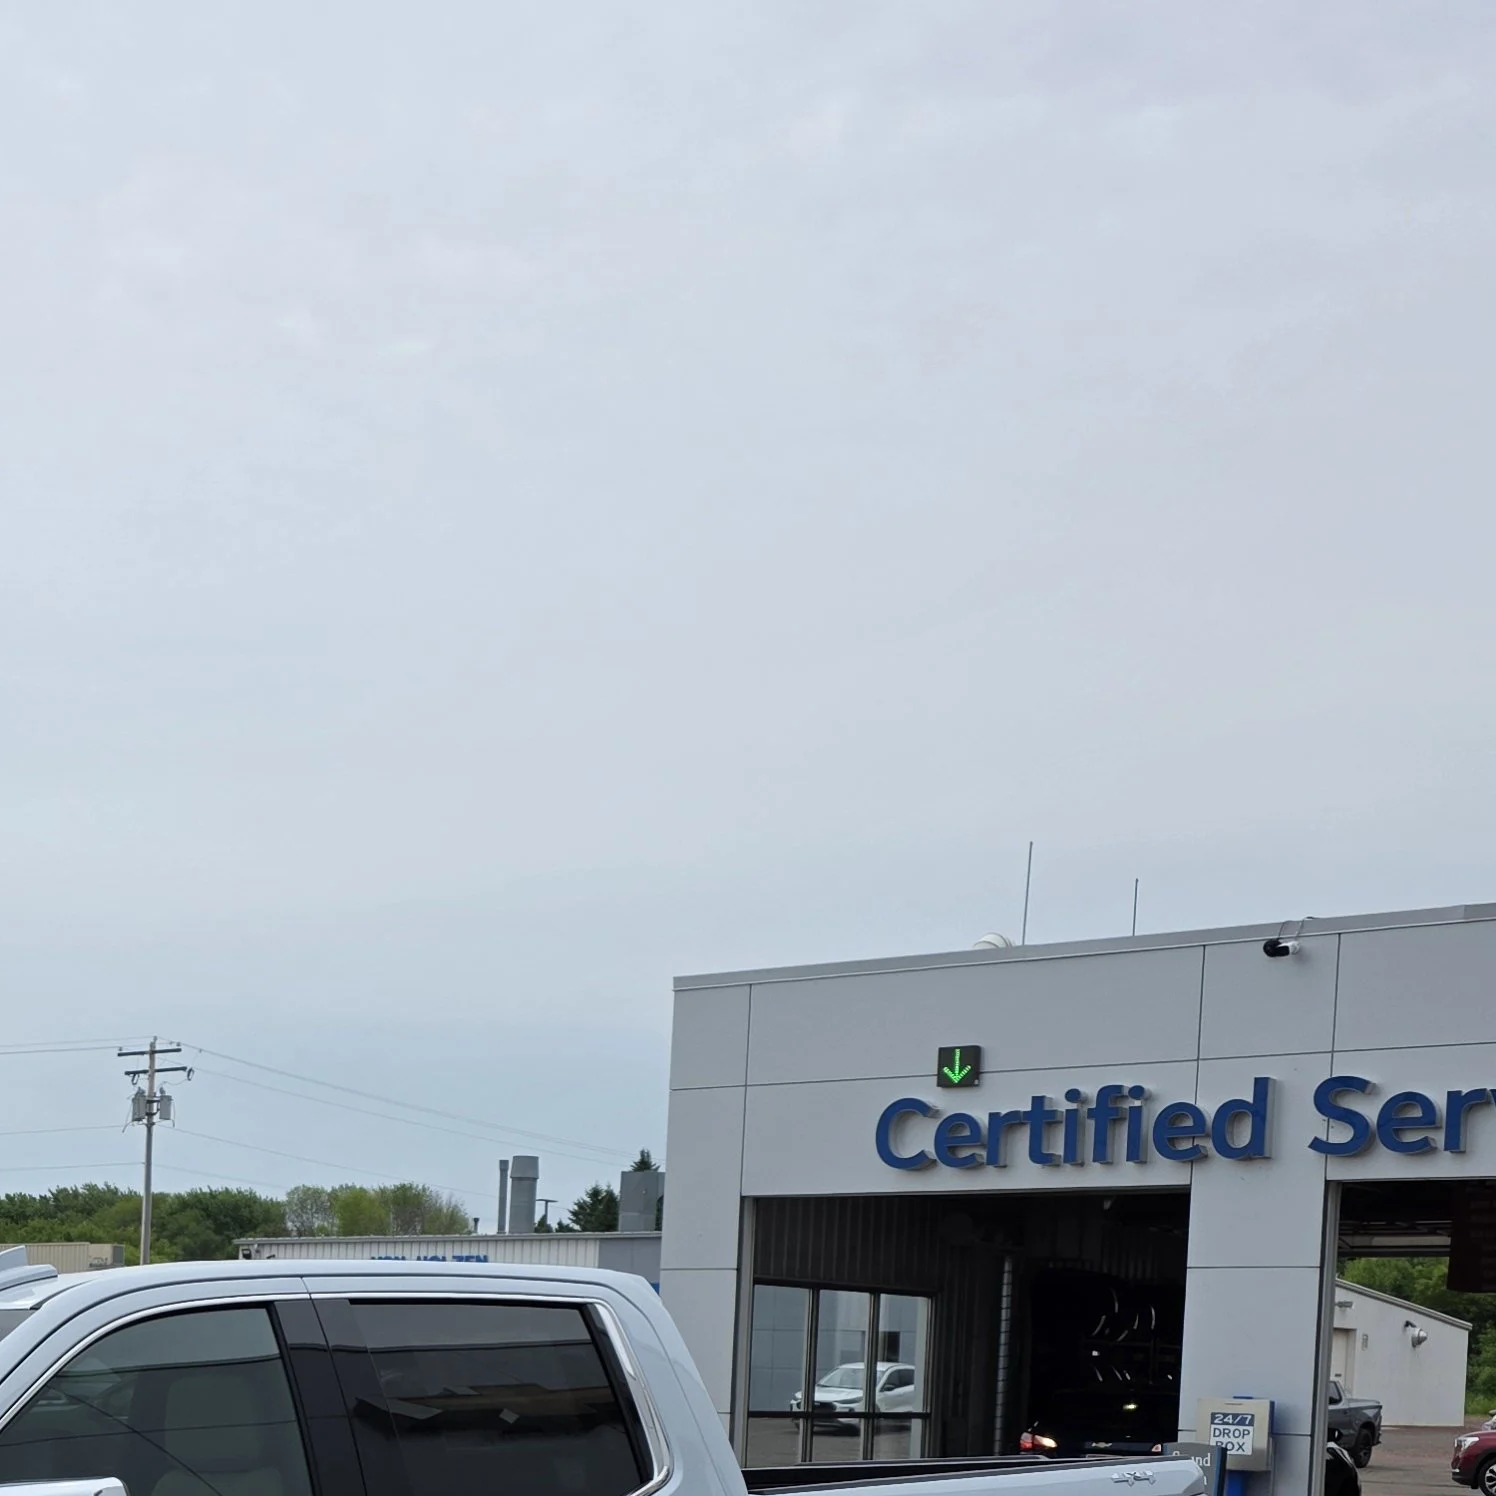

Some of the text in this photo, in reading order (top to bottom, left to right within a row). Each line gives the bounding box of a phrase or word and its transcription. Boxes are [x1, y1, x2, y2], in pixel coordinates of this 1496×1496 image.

[875, 1075, 1496, 1170] Certified Ser
[1213, 1413, 1252, 1425] 24/7
[1213, 1428, 1251, 1439] DROP
